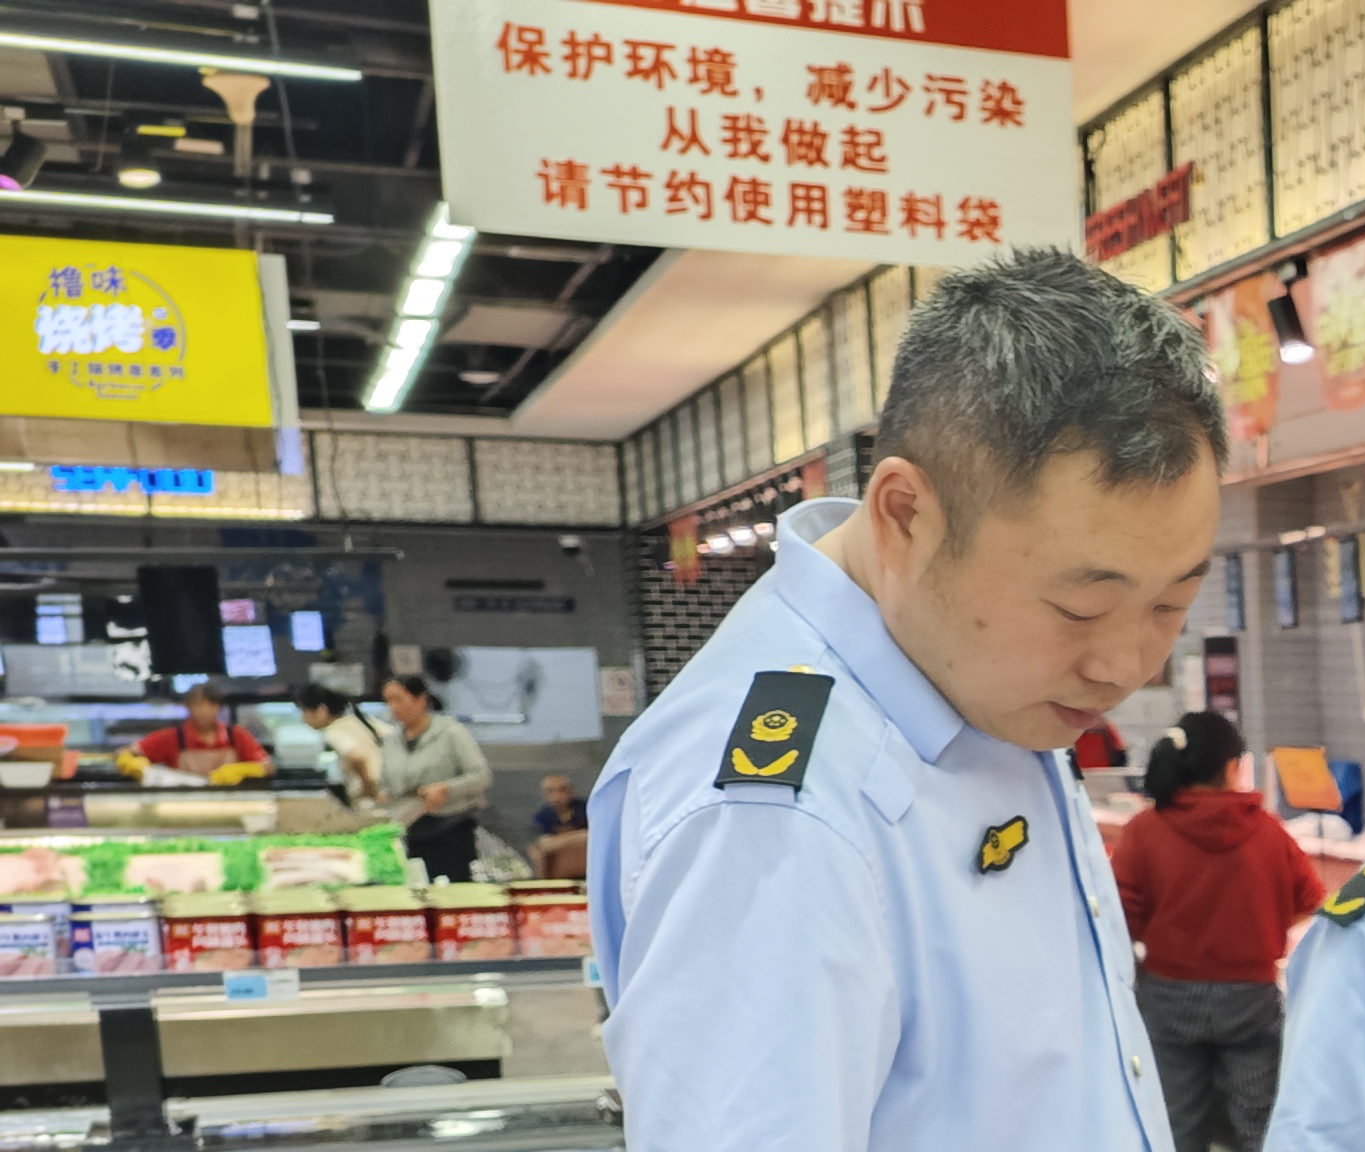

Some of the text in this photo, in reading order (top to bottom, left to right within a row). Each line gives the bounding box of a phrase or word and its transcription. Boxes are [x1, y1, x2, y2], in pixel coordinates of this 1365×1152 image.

[658, 105, 891, 175] 从我做起
[536, 158, 1004, 244] 请节约使用塑料袋
